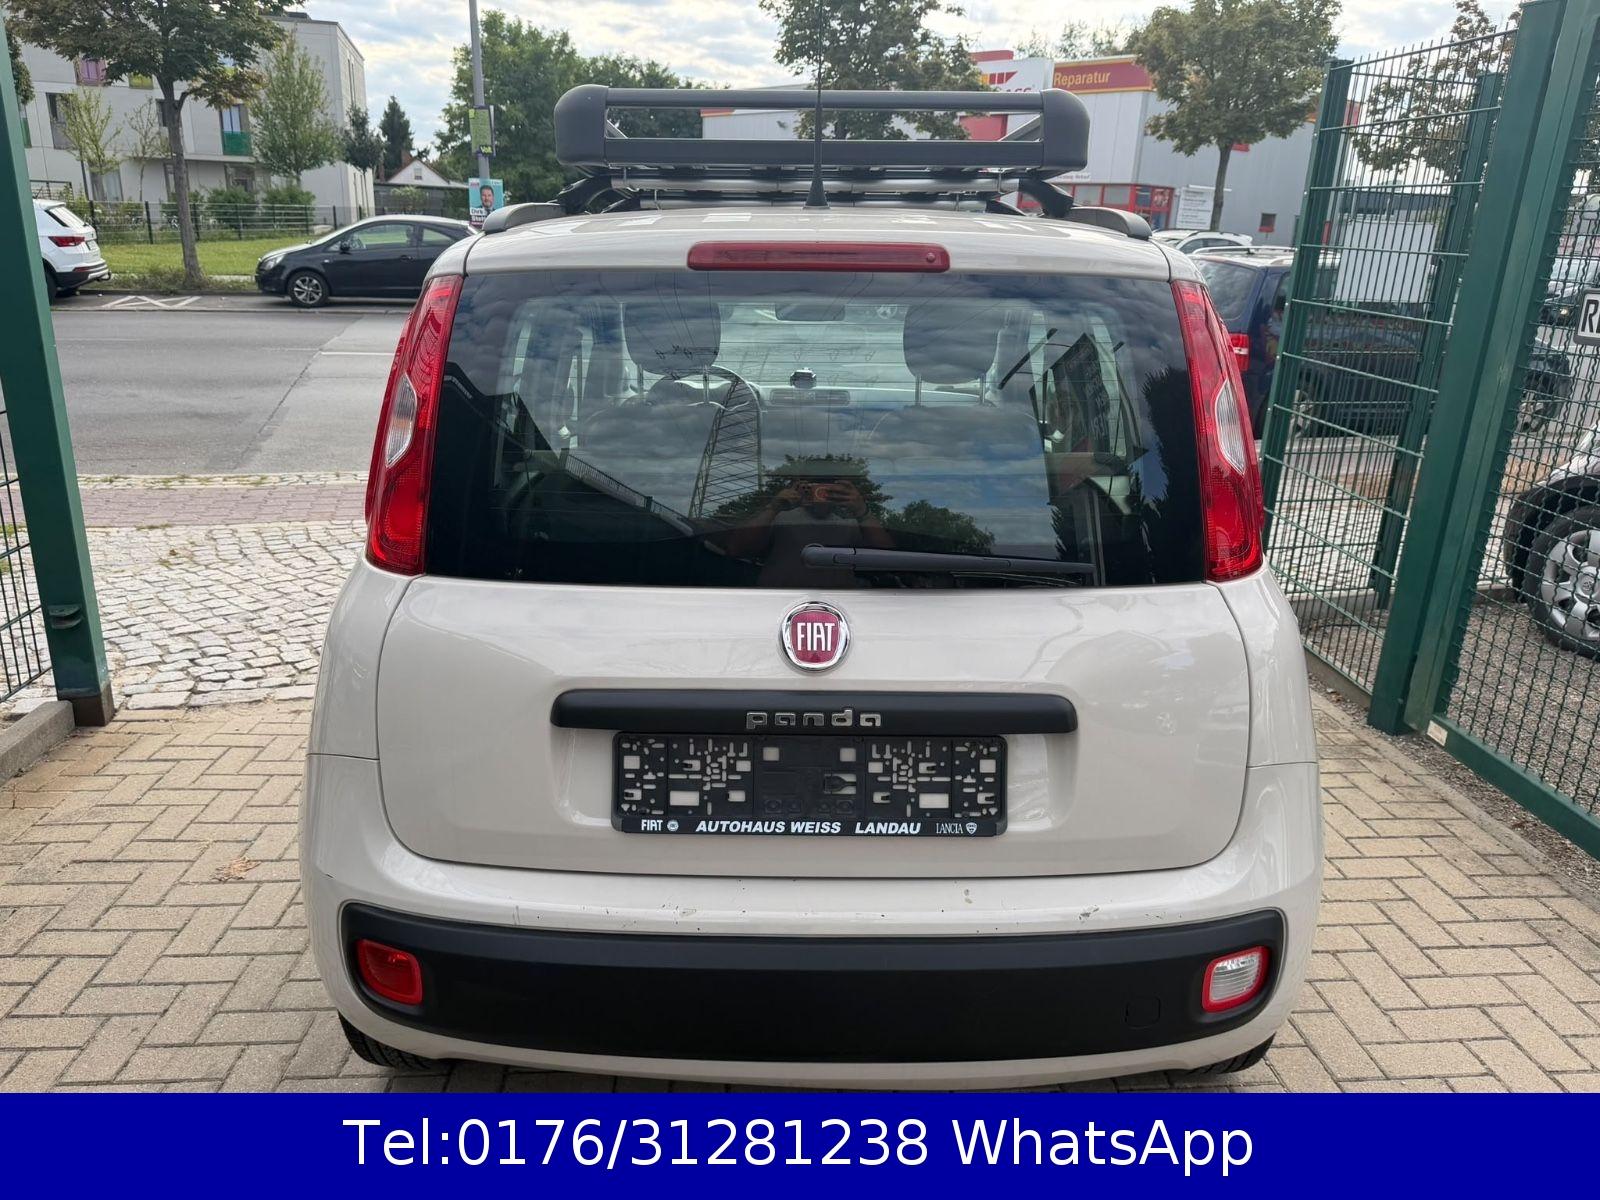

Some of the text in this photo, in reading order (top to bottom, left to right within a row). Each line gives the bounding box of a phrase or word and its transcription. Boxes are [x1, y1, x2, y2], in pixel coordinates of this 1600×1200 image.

[1054, 71, 1111, 88] Reparatur
[797, 622, 835, 652] FIAT
[746, 709, 882, 730] panda
[641, 819, 964, 835] FIAT AUTOHAUS WEISS LANDAU LANCIA
